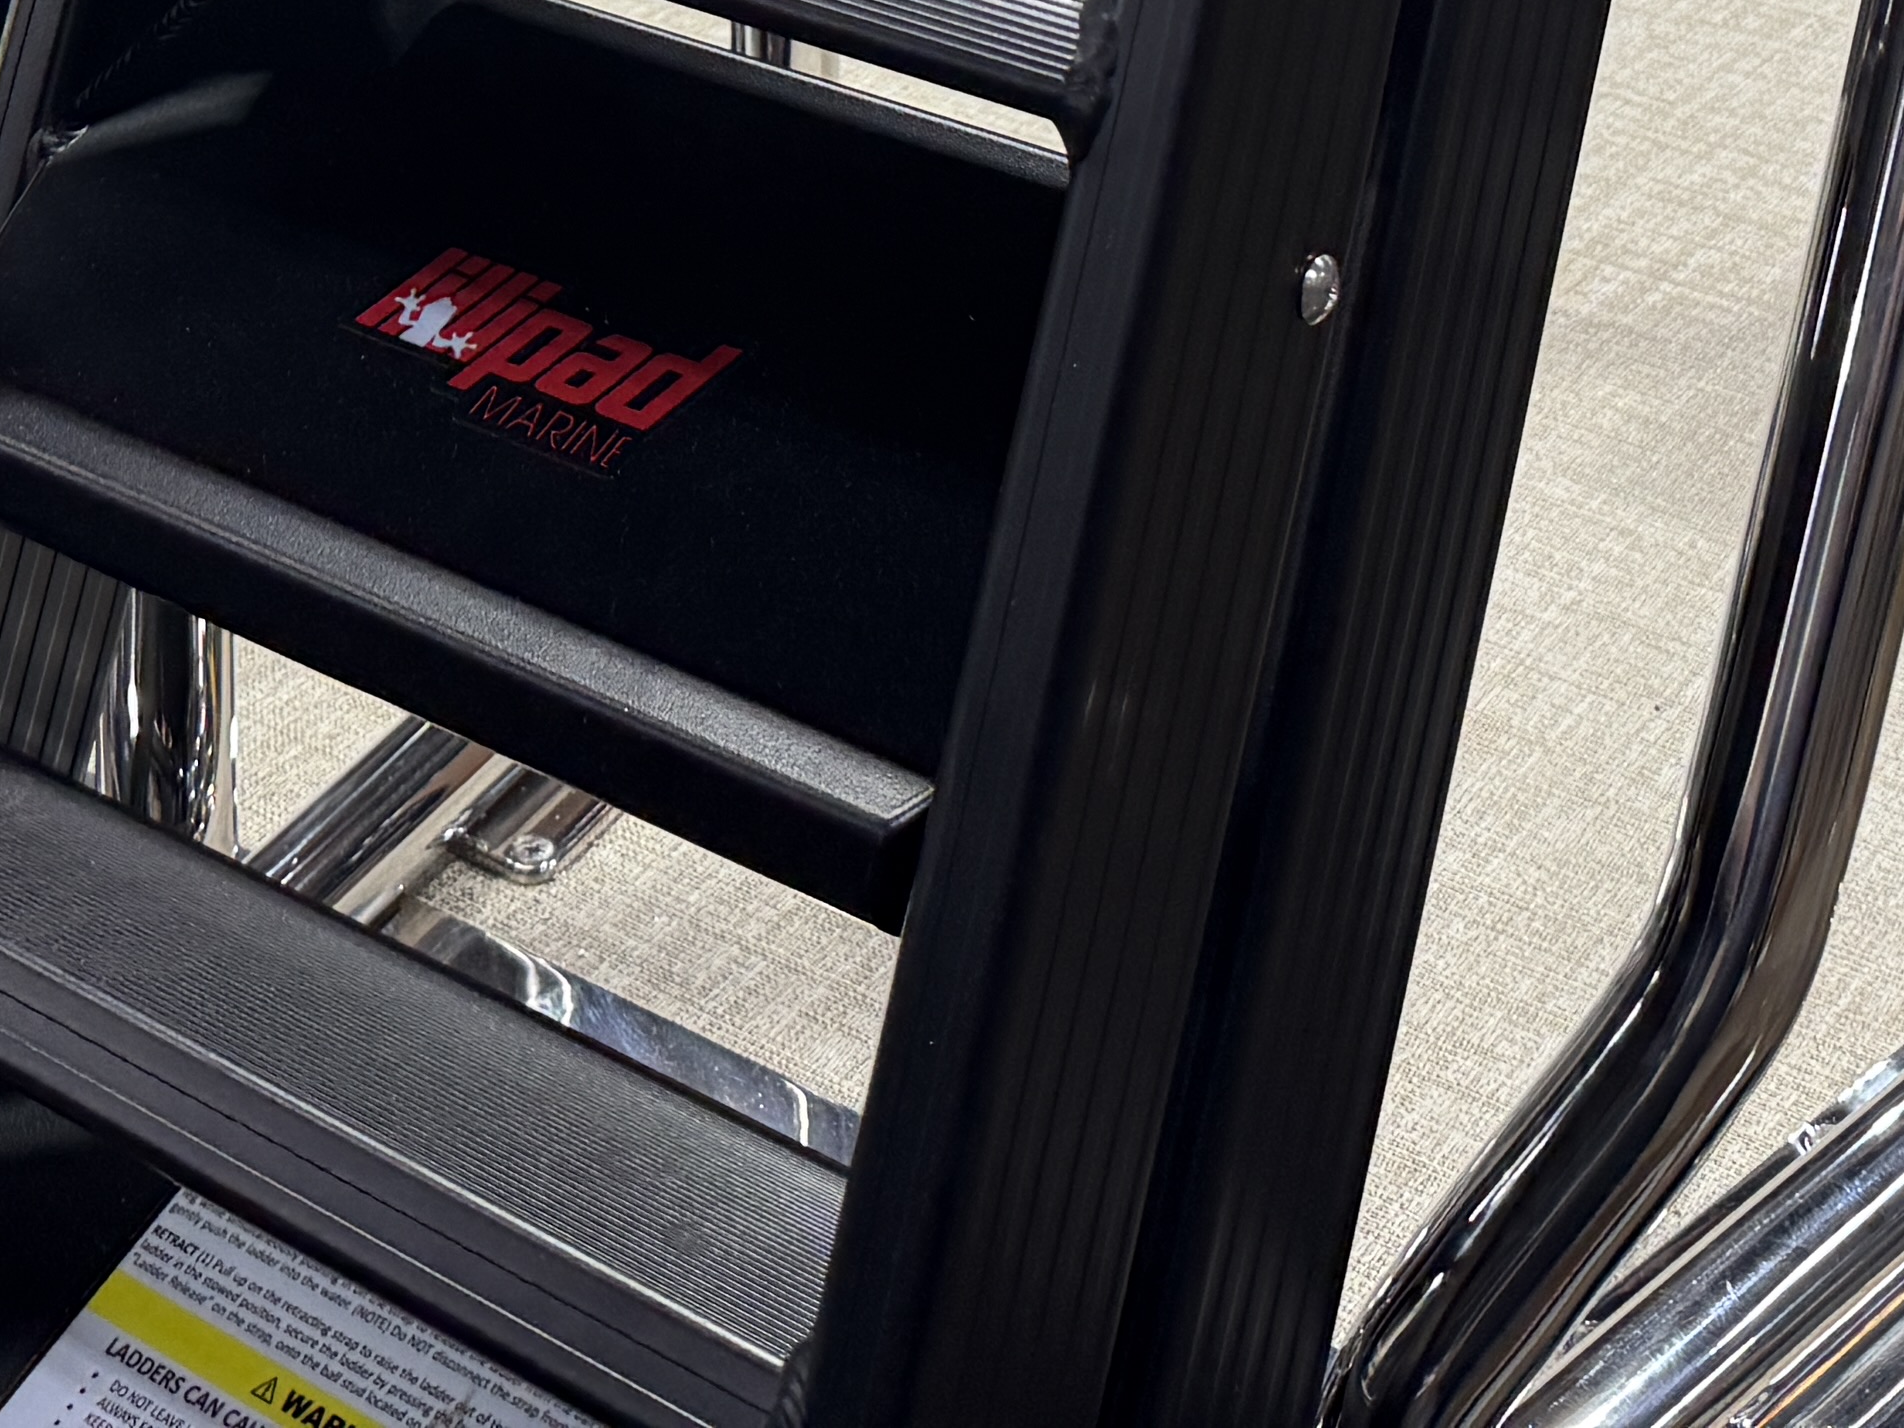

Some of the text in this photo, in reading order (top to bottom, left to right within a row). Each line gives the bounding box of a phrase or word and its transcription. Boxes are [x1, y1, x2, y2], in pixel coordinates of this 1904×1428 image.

[469, 385, 633, 468] MARINE
[140, 1237, 174, 1264] ladder
[183, 1264, 203, 1281] the
[201, 1276, 242, 1304] stowed
[283, 1324, 320, 1350] secure
[318, 1342, 339, 1360] the
[337, 1352, 375, 1381] ladder
[372, 1373, 389, 1391] by
[385, 1384, 434, 1418] pressing
[151, 1224, 200, 1257] RETRACT
[211, 1258, 237, 1277] Pull
[232, 1274, 248, 1287] up
[247, 1281, 264, 1296] on
[262, 1288, 283, 1307] the
[280, 1300, 333, 1338] retracting
[330, 1330, 360, 1352] strap
[359, 1344, 373, 1359] to
[373, 1353, 400, 1375] raise
[398, 1368, 420, 1386] the
[418, 1377, 456, 1406] ladder
[168, 1202, 204, 1227] gently
[199, 1220, 228, 1239] push
[227, 1232, 247, 1250] the
[245, 1243, 281, 1267] ladder
[279, 1263, 301, 1281] into
[300, 1275, 320, 1292] the
[389, 1325, 408, 1342] Do
[407, 1334, 434, 1355] NOT
[431, 1351, 492, 1390] disconnect
[489, 1382, 511, 1402] the
[508, 1396, 540, 1419] strap
[210, 1302, 227, 1317] on
[225, 1311, 246, 1328] the
[274, 1340, 302, 1360] onto
[300, 1353, 321, 1372] the
[319, 1363, 344, 1384] ball
[339, 1378, 368, 1398] stud
[364, 1390, 409, 1423] located
[104, 1337, 186, 1395] LADDERS
[183, 1385, 226, 1419] CAN
[109, 1379, 130, 1398] DO
[126, 1390, 154, 1412] NOT
